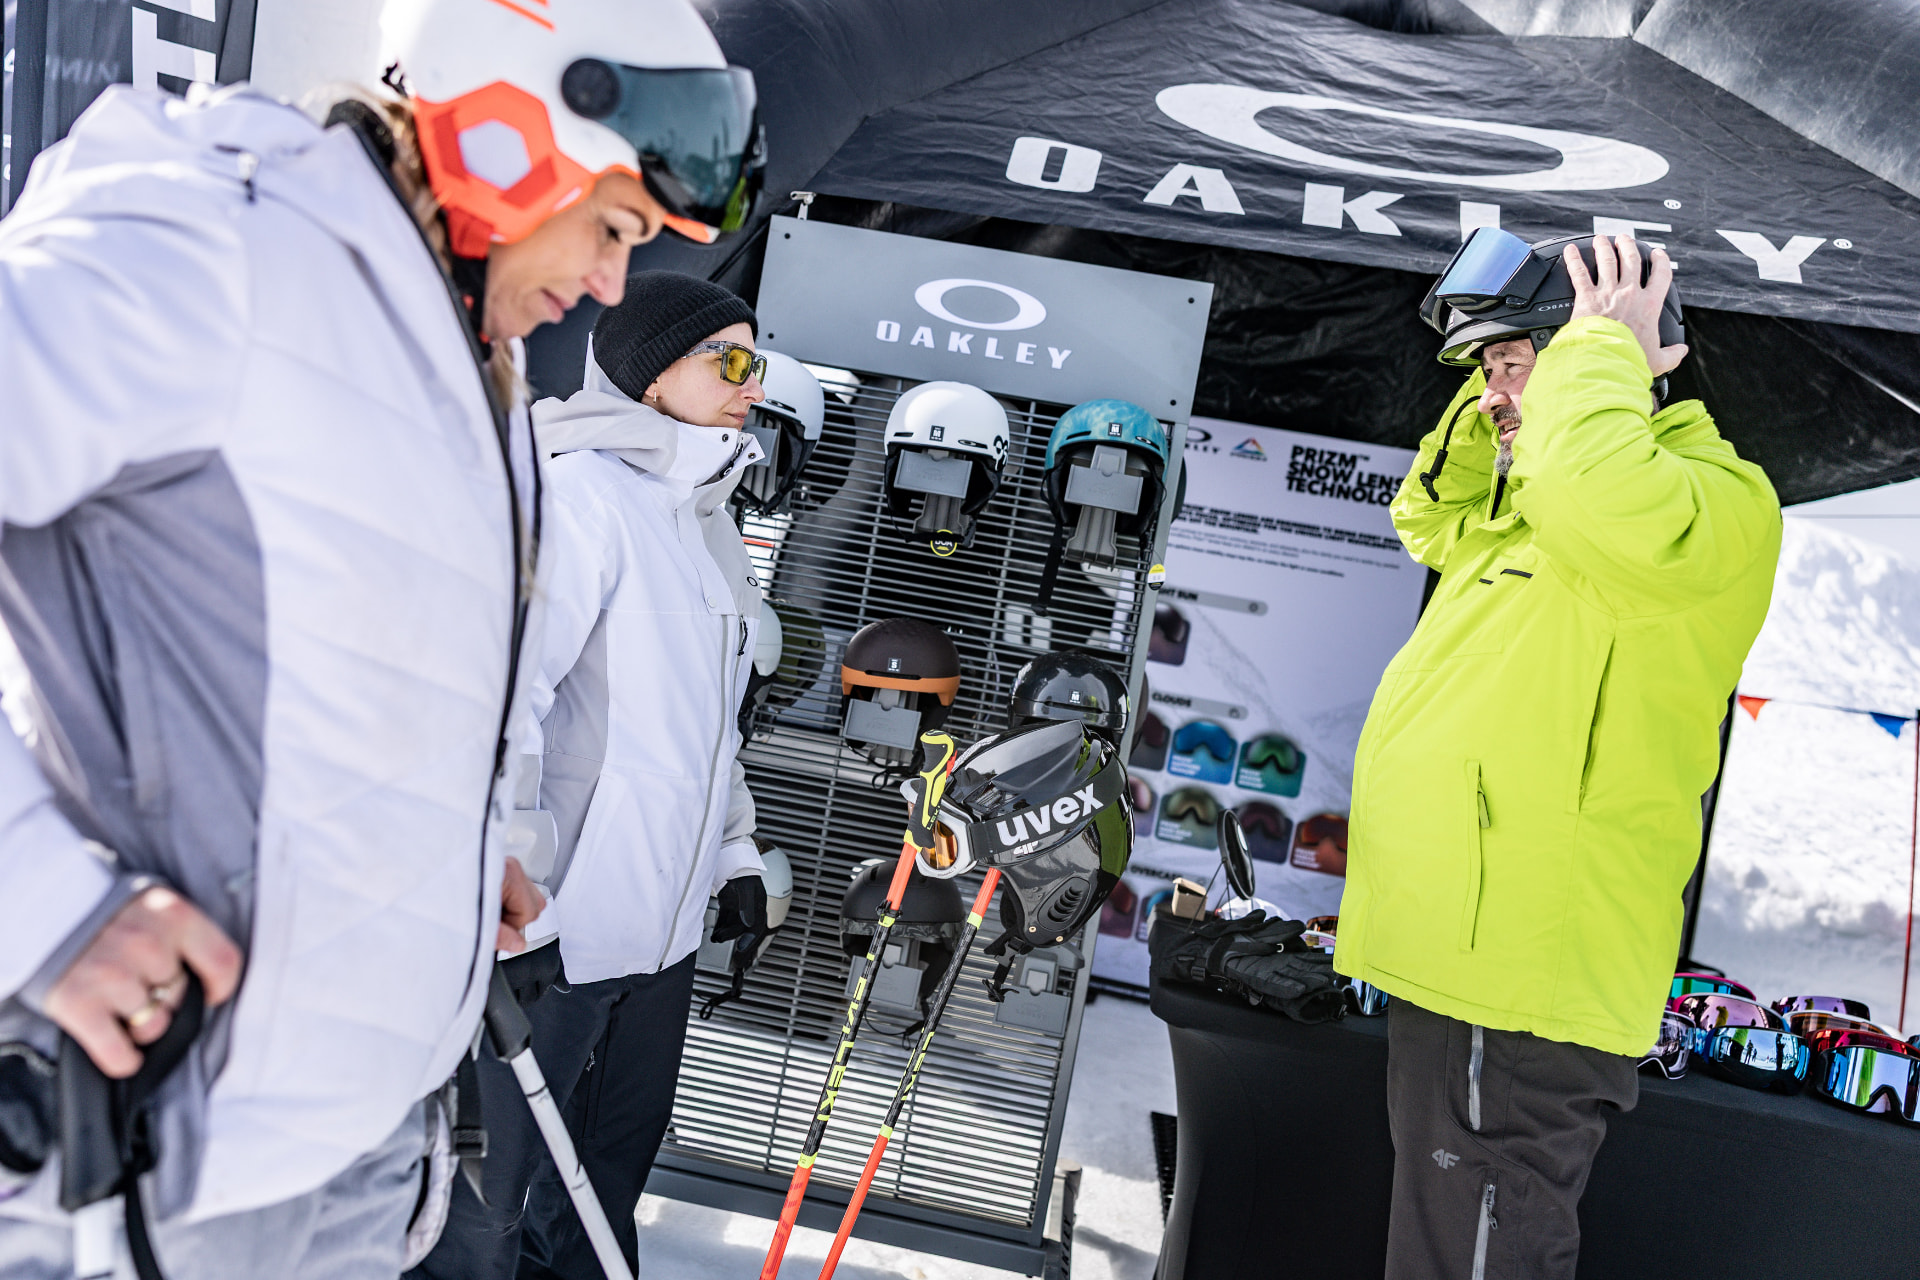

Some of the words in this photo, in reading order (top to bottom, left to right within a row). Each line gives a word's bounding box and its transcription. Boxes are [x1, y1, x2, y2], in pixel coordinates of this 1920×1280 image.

[1551, 302, 1574, 311] OAK
[876, 320, 1072, 370] OAKLEY
[1287, 460, 1354, 484] SNOW
[1286, 475, 1394, 507] TECHNOLO
[996, 783, 1104, 846] uvex
[816, 1041, 854, 1121] LEKI
[1431, 1148, 1460, 1170] 4F
